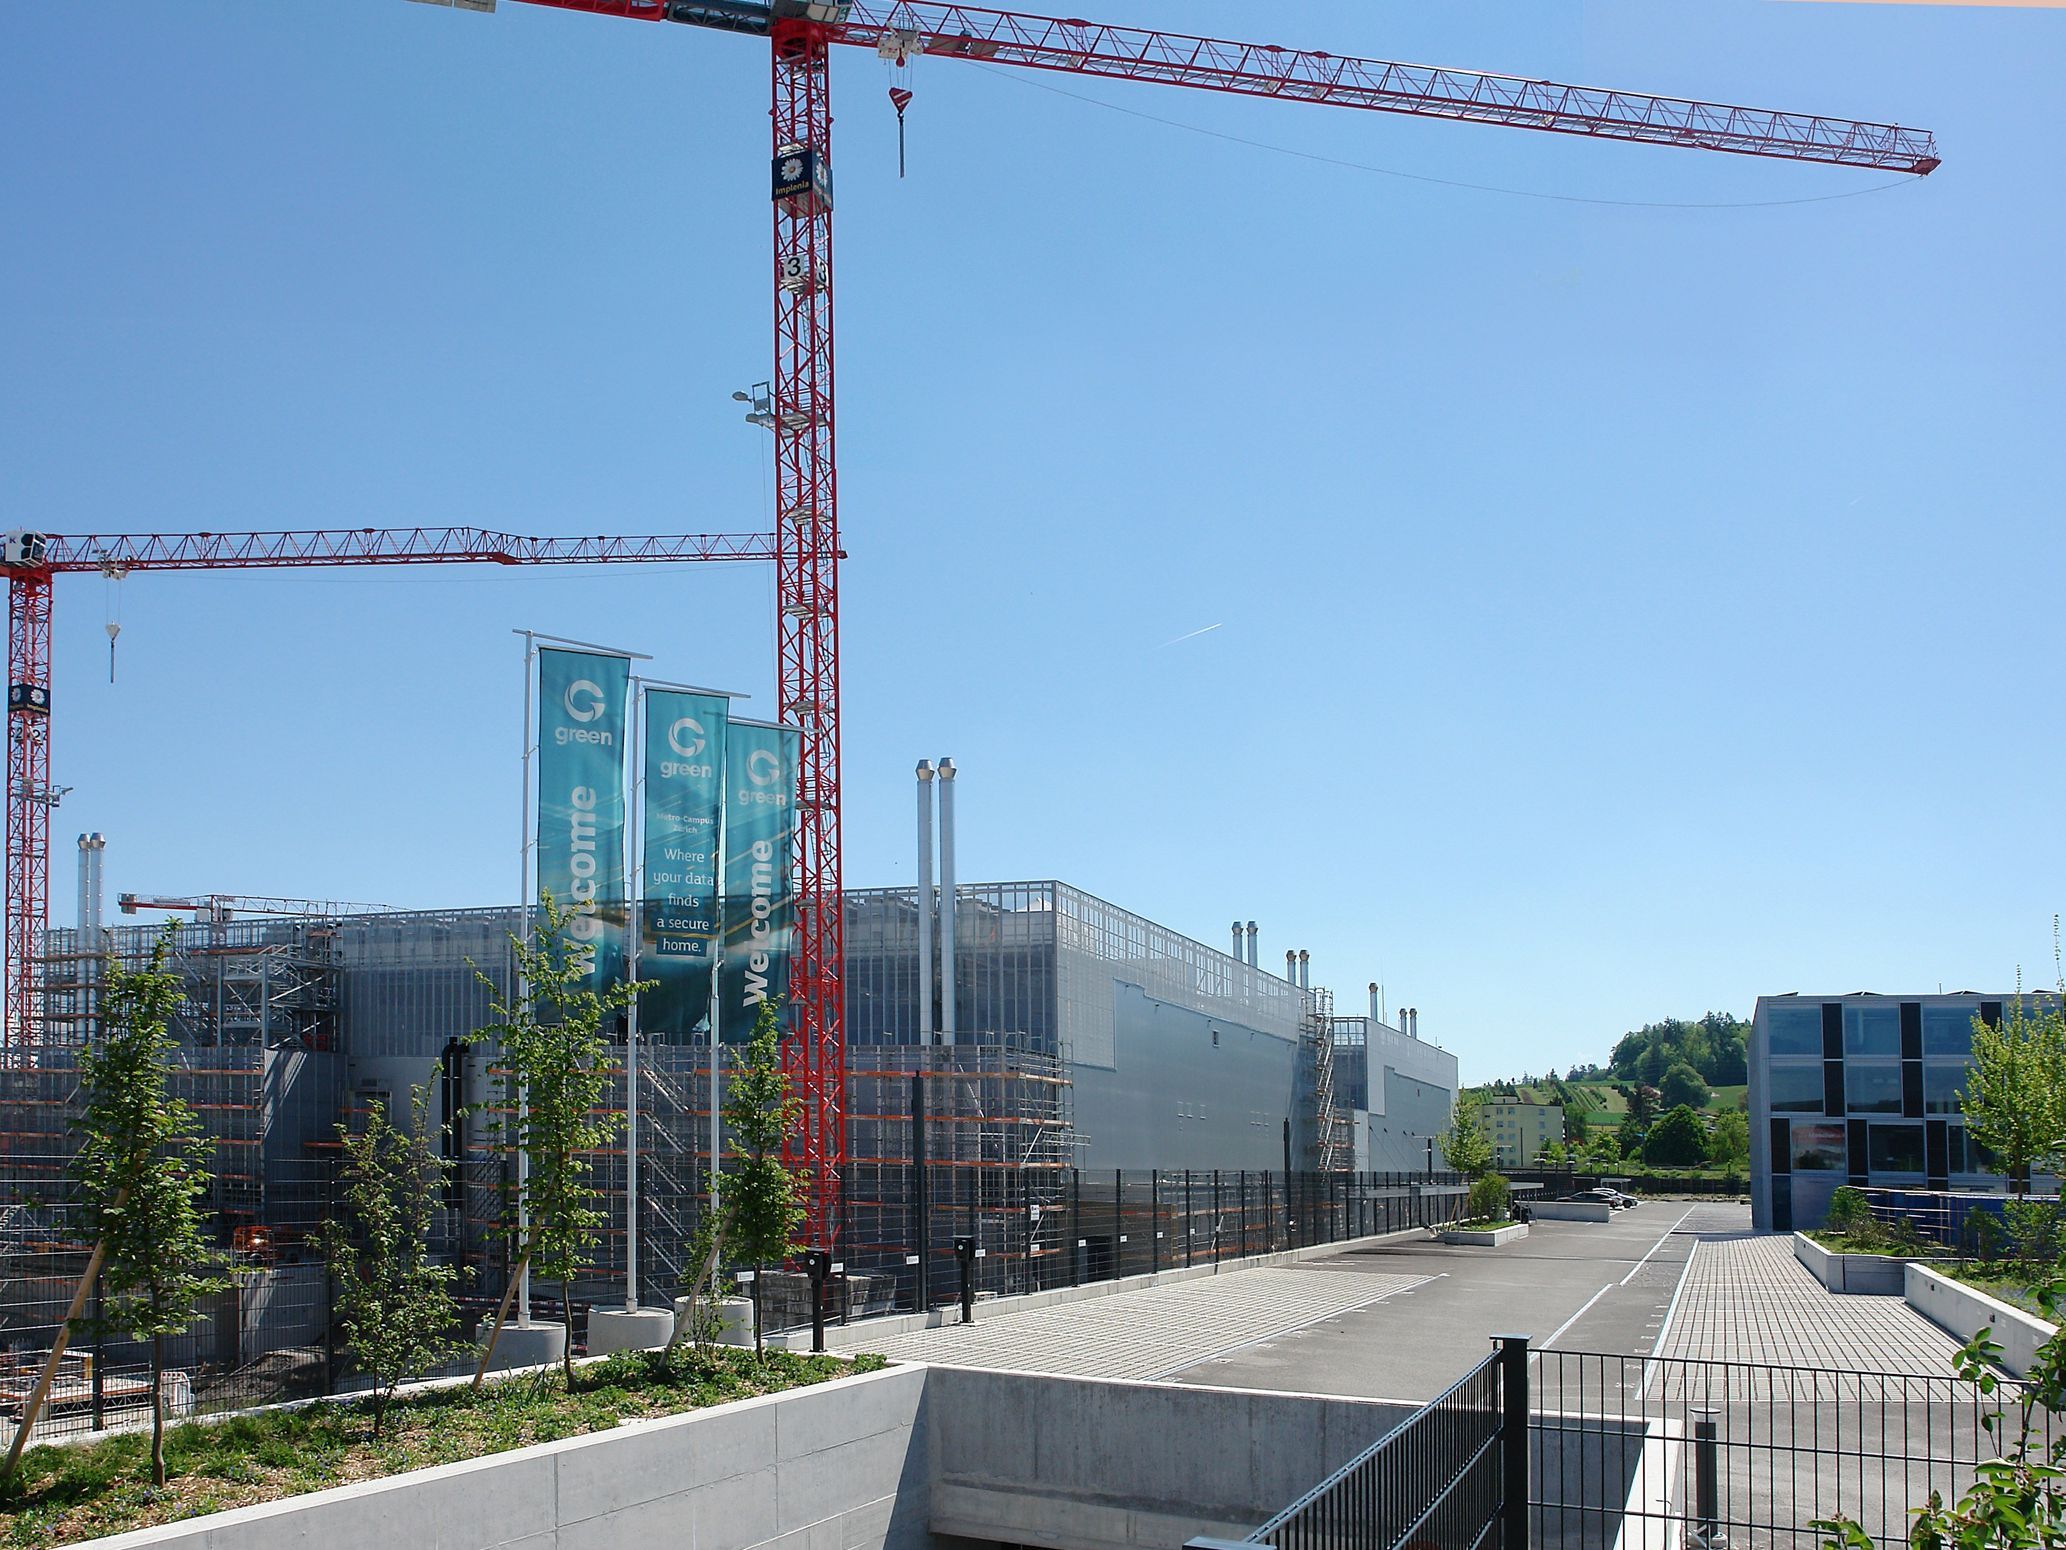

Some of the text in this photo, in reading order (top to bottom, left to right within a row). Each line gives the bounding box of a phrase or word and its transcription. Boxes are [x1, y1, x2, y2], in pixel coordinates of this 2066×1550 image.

[787, 257, 801, 277] 3
[555, 726, 613, 746] green
[660, 761, 712, 779] green
[738, 789, 786, 806] green
[664, 848, 705, 862] Where
[653, 872, 714, 887] your data
[668, 893, 700, 908] finds
[656, 918, 710, 931] a secure
[662, 938, 702, 953] home.
